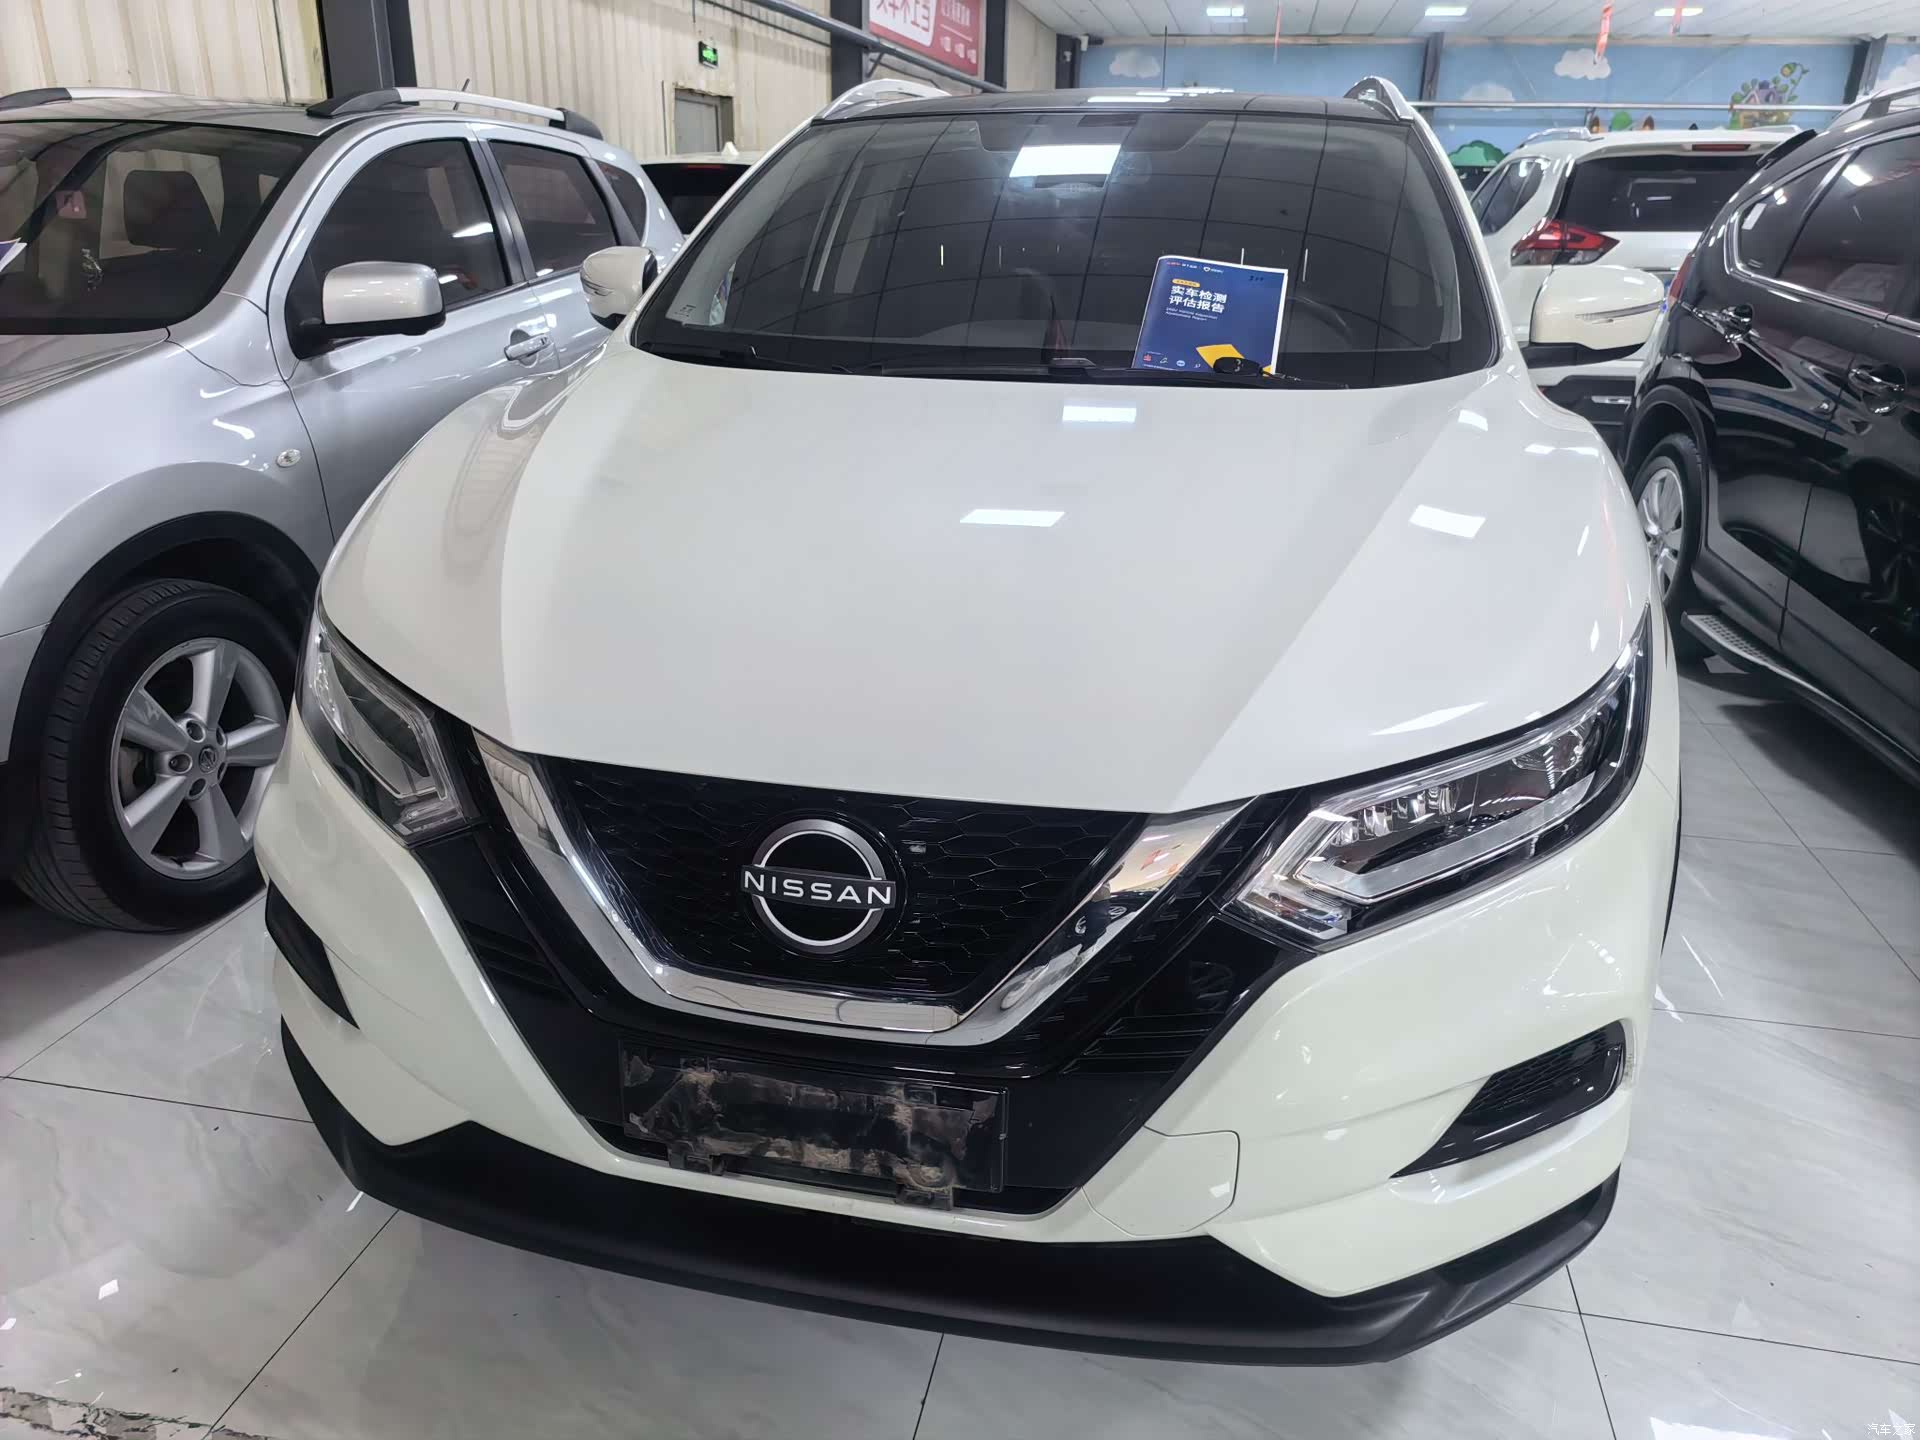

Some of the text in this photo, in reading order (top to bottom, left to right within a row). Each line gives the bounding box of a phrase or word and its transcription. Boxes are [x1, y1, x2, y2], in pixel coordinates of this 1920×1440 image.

[1169, 295, 1225, 314] 评估报告
[1171, 286, 1227, 304] 实车检测
[744, 870, 892, 905] NISSAN
